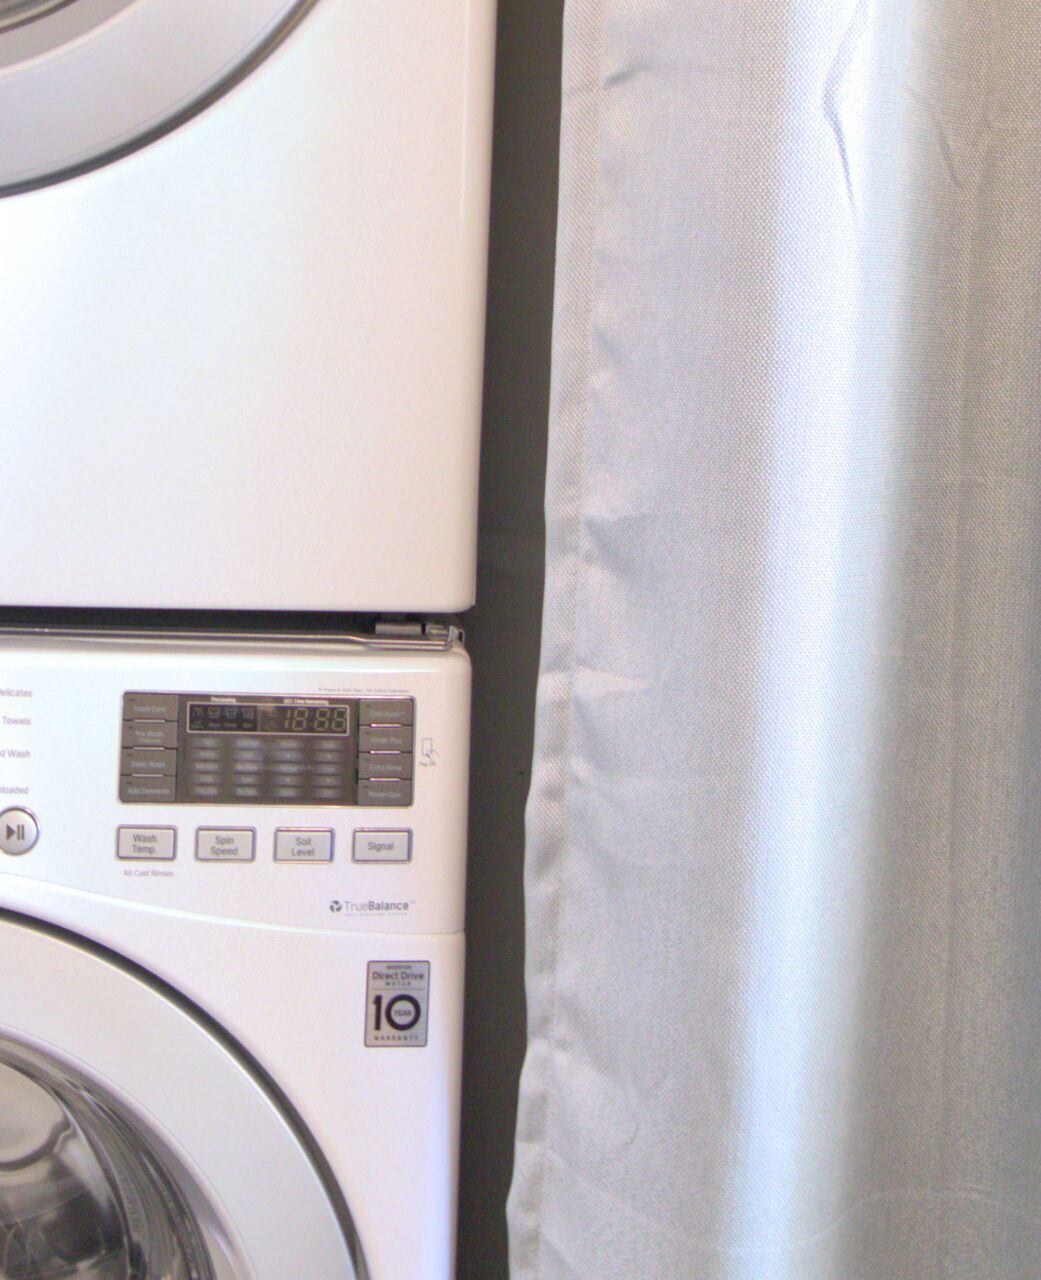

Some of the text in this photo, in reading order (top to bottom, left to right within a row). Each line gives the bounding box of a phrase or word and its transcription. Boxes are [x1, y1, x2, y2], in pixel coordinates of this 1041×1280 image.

[2, 715, 31, 726] Towels
[7, 749, 31, 759] Wash
[132, 833, 157, 844] Wash
[215, 835, 235, 846] Spin
[295, 836, 312, 846] Soil
[131, 844, 156, 855] Temp.
[210, 846, 239, 857] Speed
[367, 840, 395, 852] Signal
[291, 847, 315, 857] Level
[372, 971, 425, 980] Direct Drive
[372, 993, 422, 1032] 10
